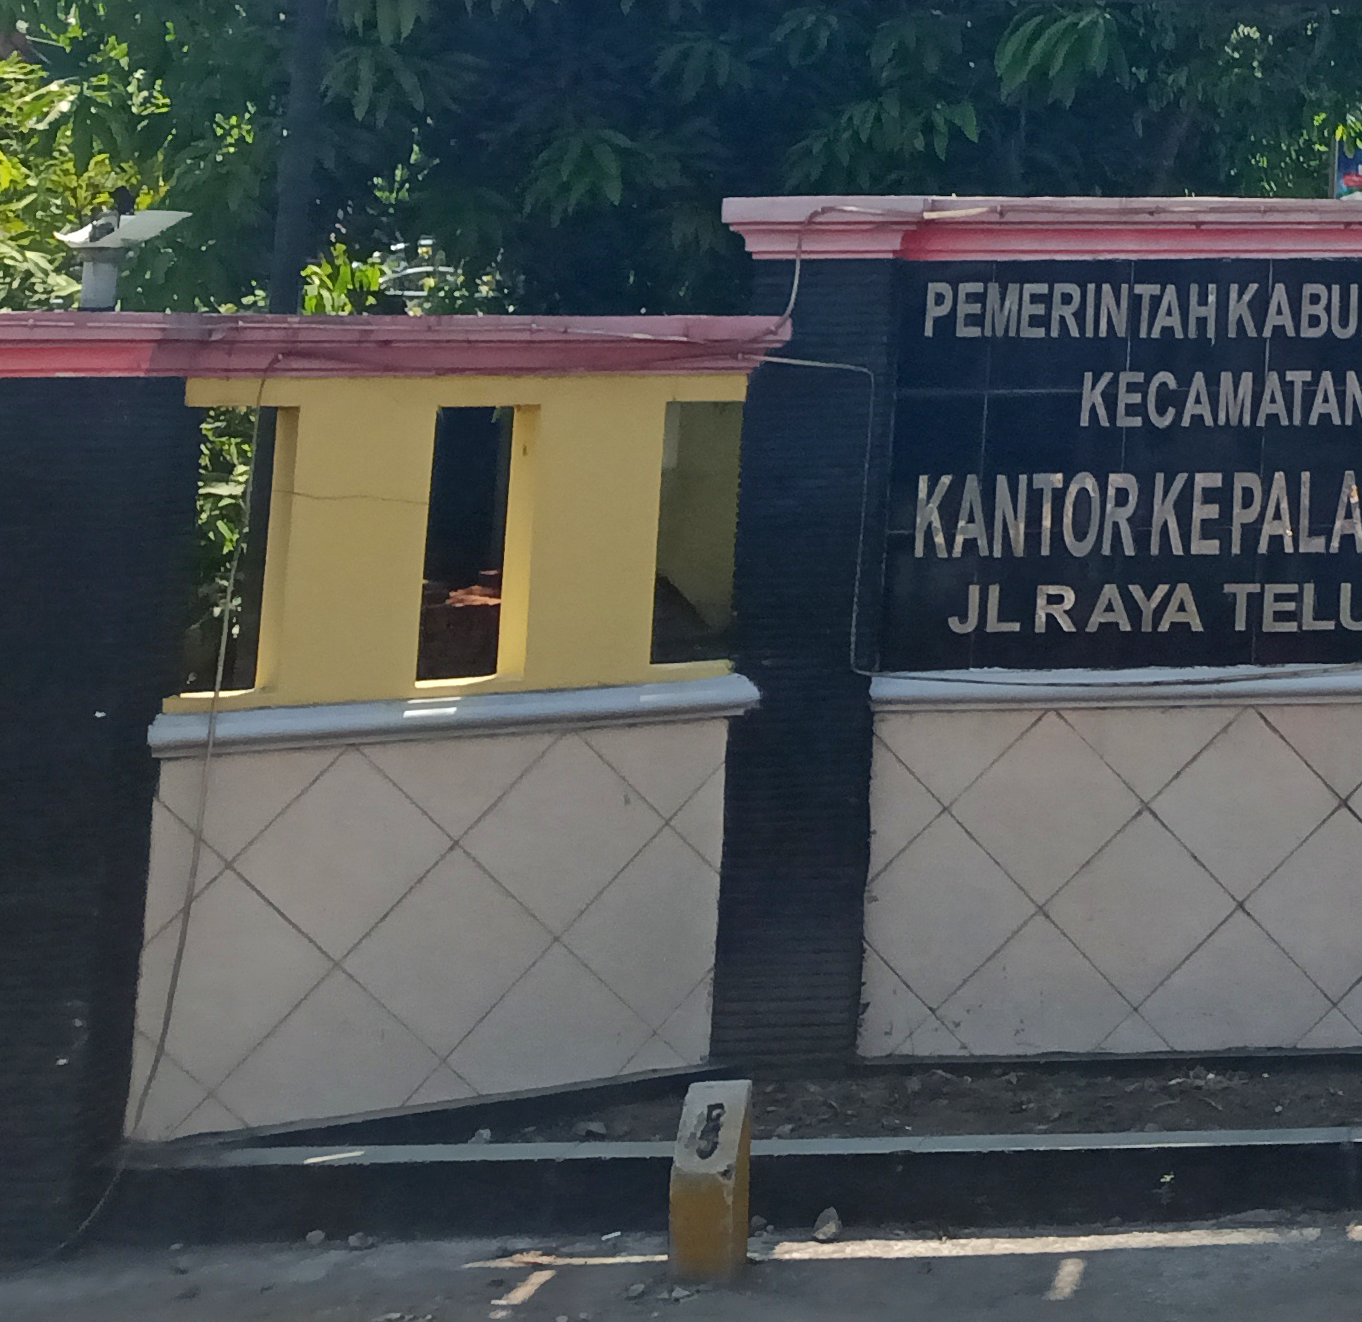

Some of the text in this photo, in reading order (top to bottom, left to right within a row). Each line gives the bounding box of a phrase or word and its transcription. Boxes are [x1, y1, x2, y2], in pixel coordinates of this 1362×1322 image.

[925, 282, 1216, 340] PEMERINTAH
[915, 472, 1138, 557] KANTOR
[948, 584, 1020, 633] JL
[1035, 583, 1203, 632] RAYA
